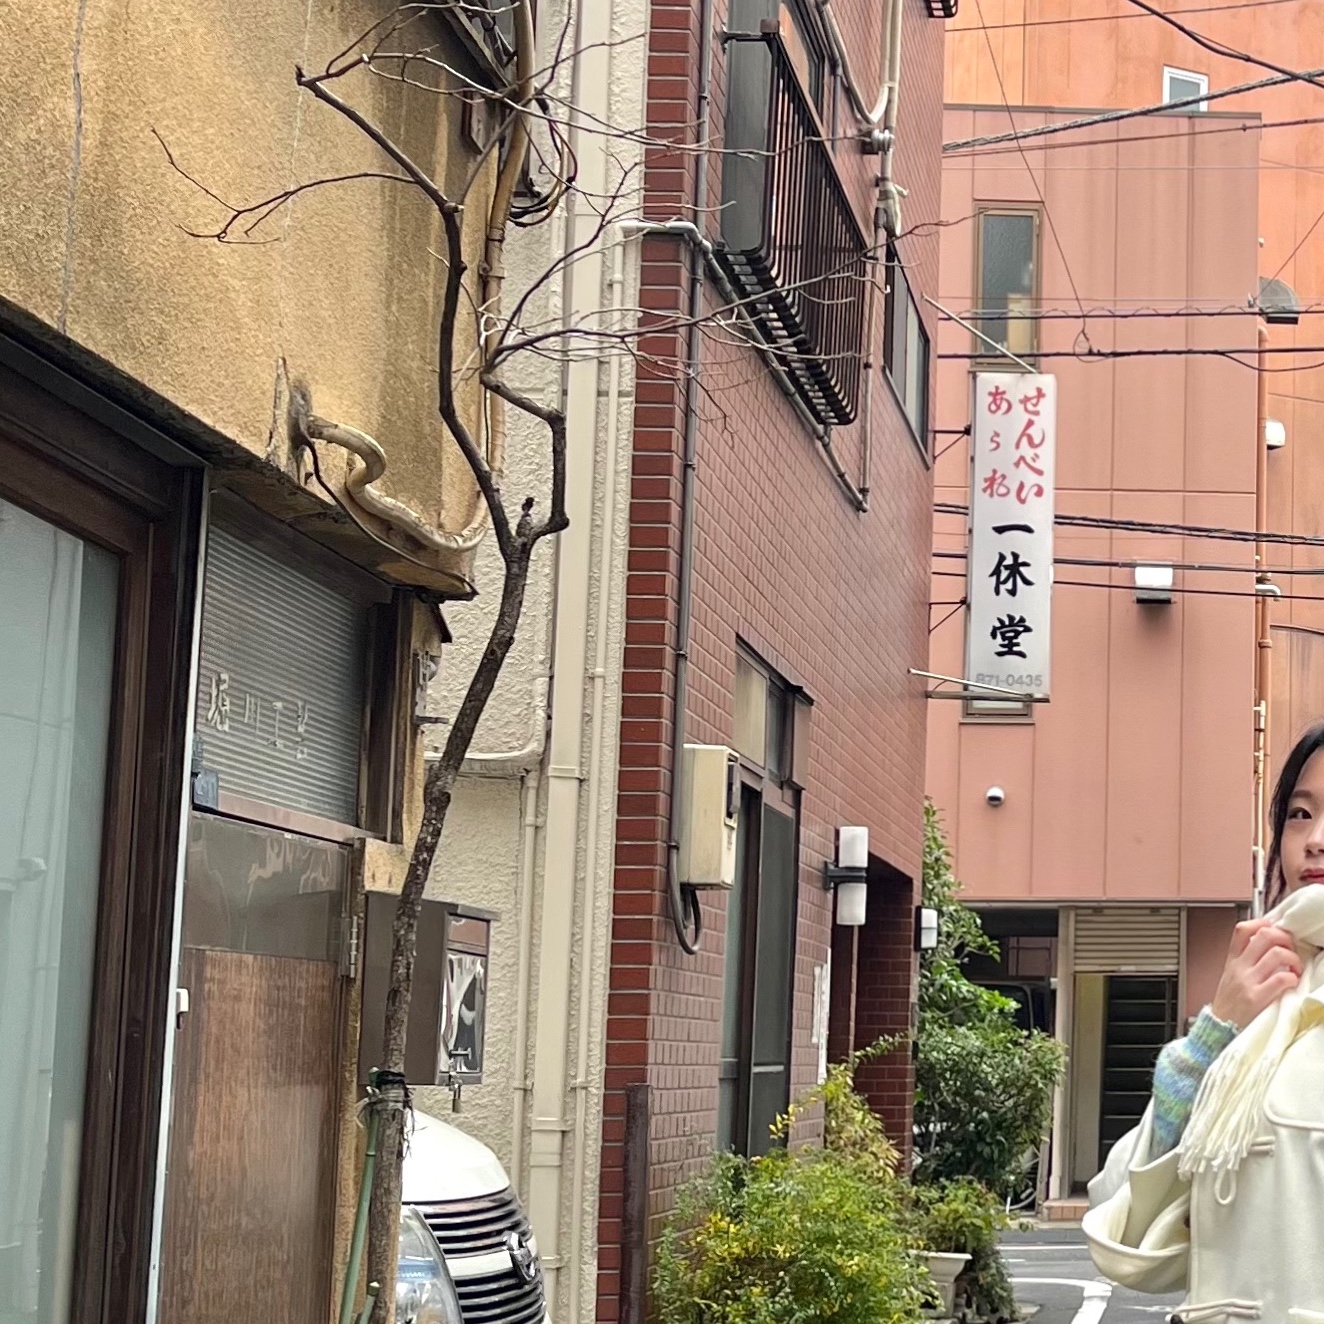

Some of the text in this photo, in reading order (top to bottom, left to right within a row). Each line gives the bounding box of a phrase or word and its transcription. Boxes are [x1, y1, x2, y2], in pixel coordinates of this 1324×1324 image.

[982, 385, 1013, 498] あられ
[1013, 386, 1046, 505] せんべい
[988, 524, 1035, 659] 一休堂
